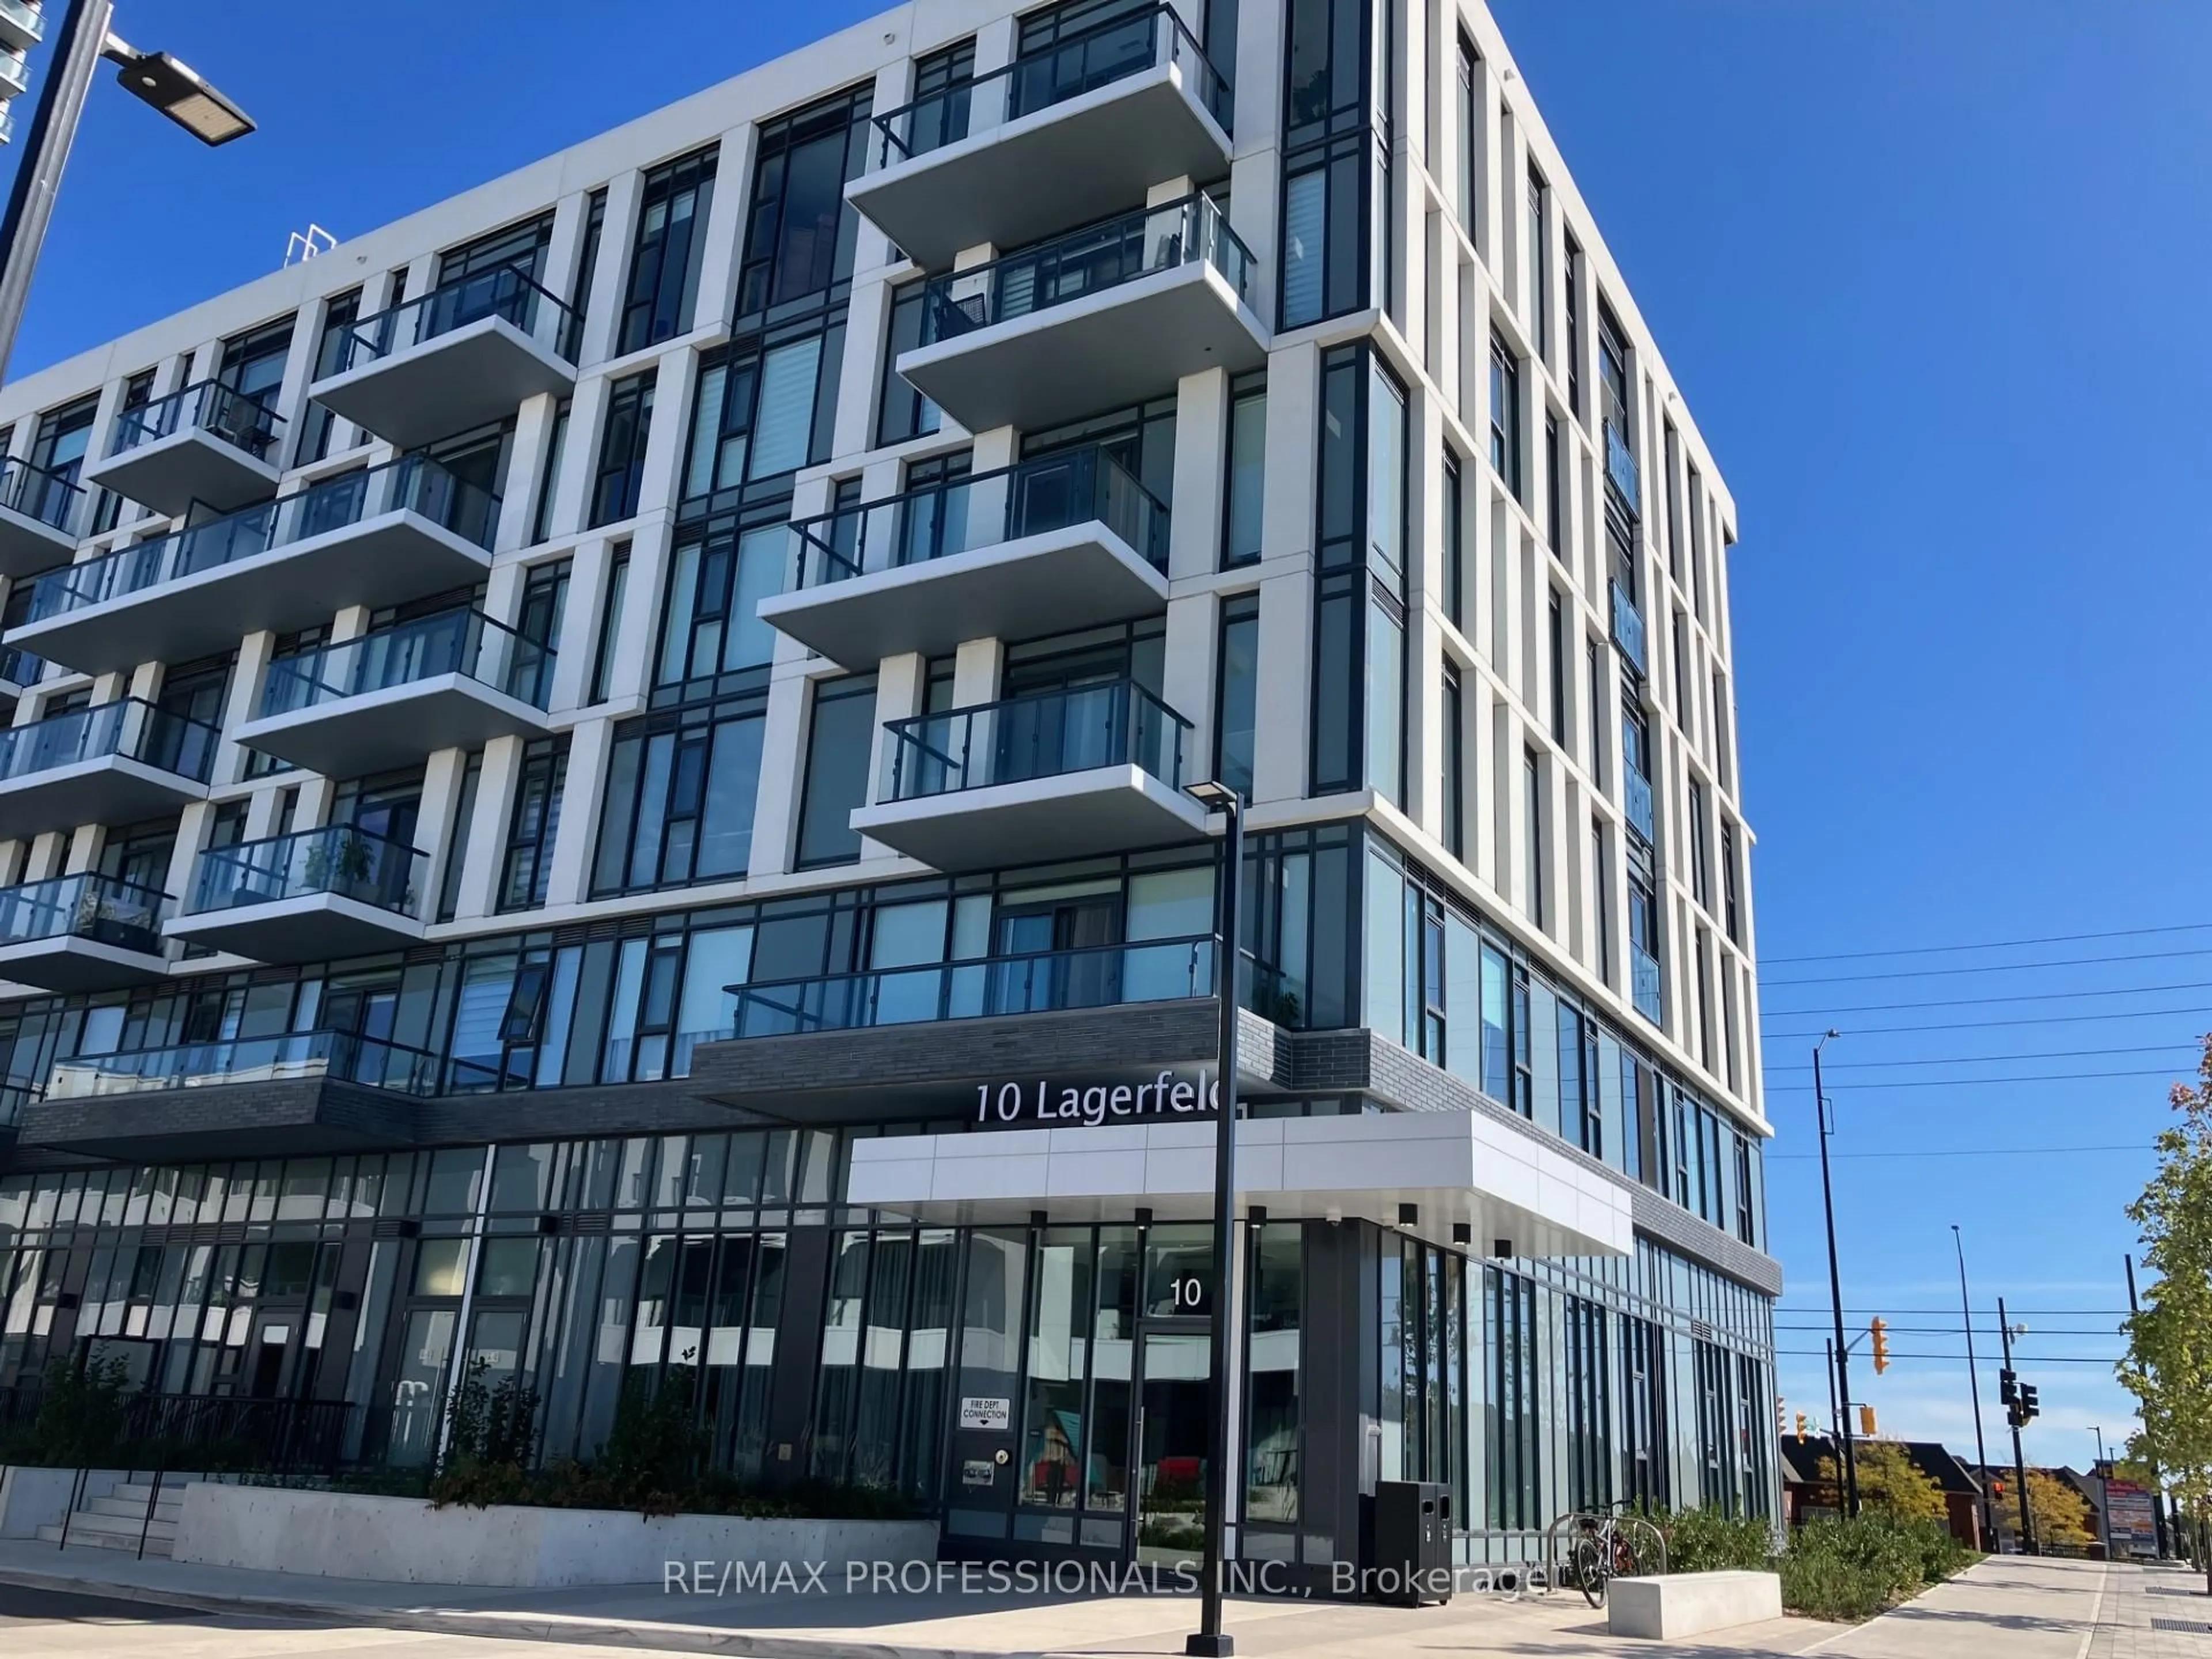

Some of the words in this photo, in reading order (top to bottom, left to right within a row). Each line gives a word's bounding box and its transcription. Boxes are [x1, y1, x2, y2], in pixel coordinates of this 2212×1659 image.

[977, 1081, 1021, 1123] 10
[1170, 1278, 1202, 1306] 10
[963, 1409, 1007, 1419] CONNECTION
[971, 1400, 983, 1409] FIRE
